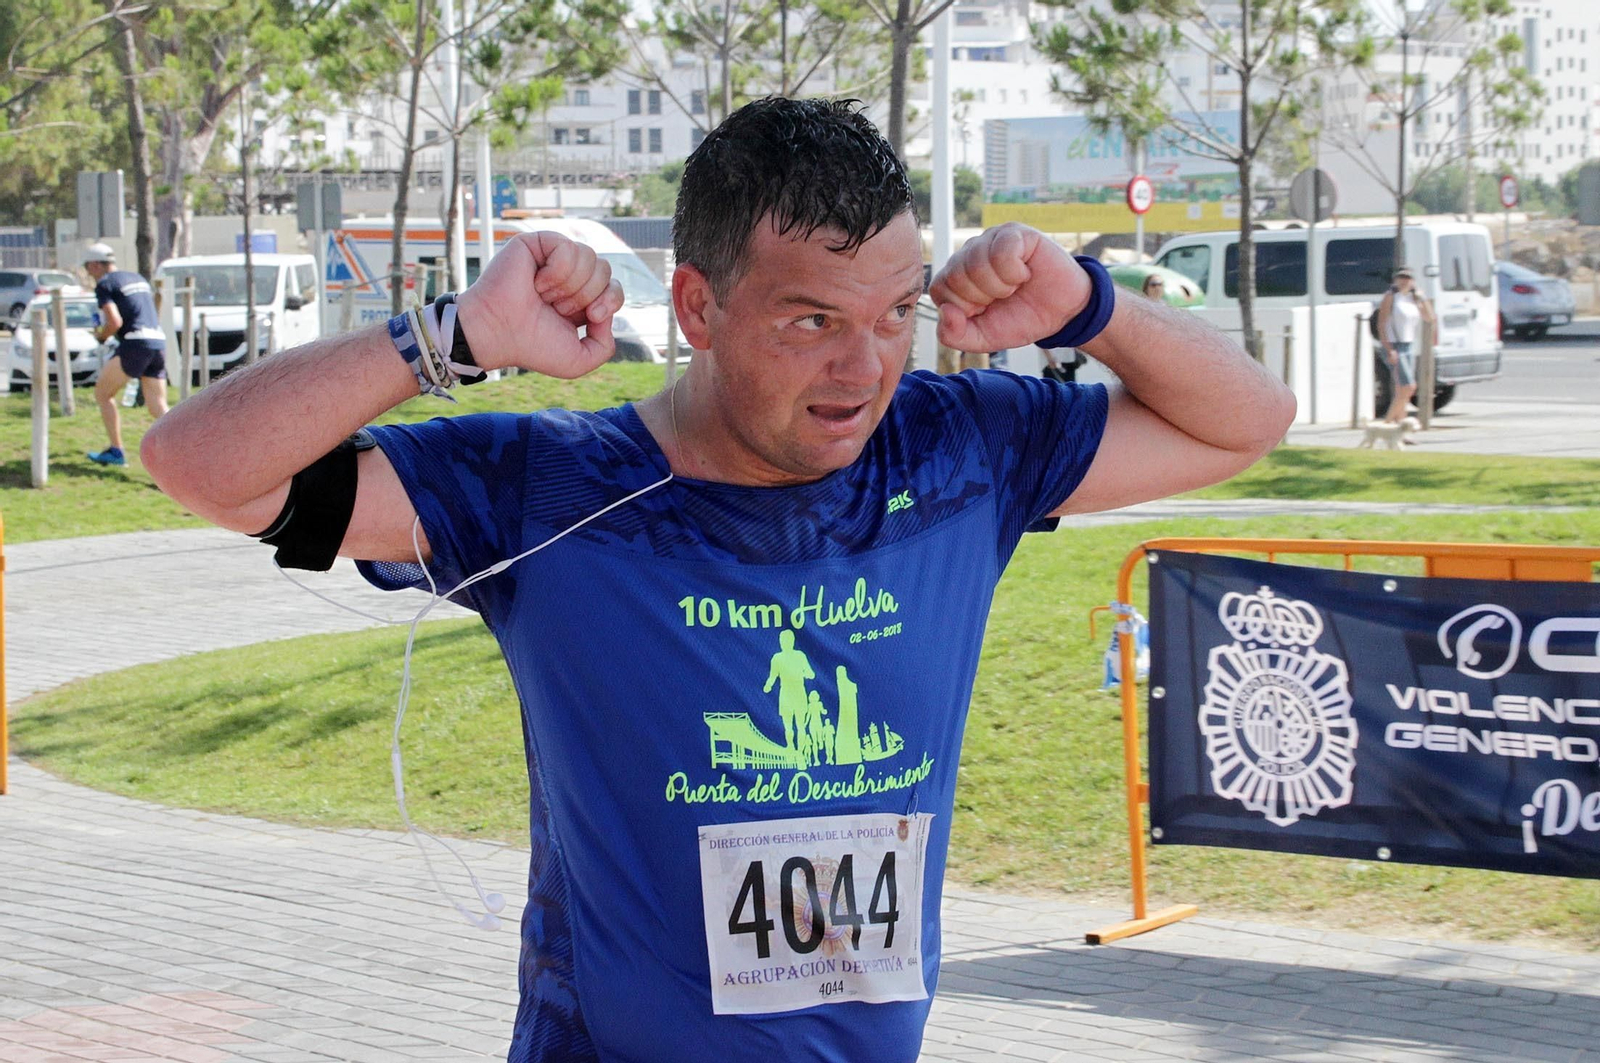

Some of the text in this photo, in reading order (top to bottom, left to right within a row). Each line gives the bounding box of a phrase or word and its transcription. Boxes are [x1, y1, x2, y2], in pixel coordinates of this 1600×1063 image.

[678, 577, 899, 629] 10 km Huelva
[1385, 683, 1600, 725] VIOLENC
[665, 751, 934, 804] Puerta del Descubrimiento
[709, 825, 895, 849] DIRECCIÓN GENERAL DE LA POLICÍA
[728, 851, 900, 959] 4044
[723, 957, 836, 986] AGRUPACIÓN
[818, 980, 845, 996] 4044
